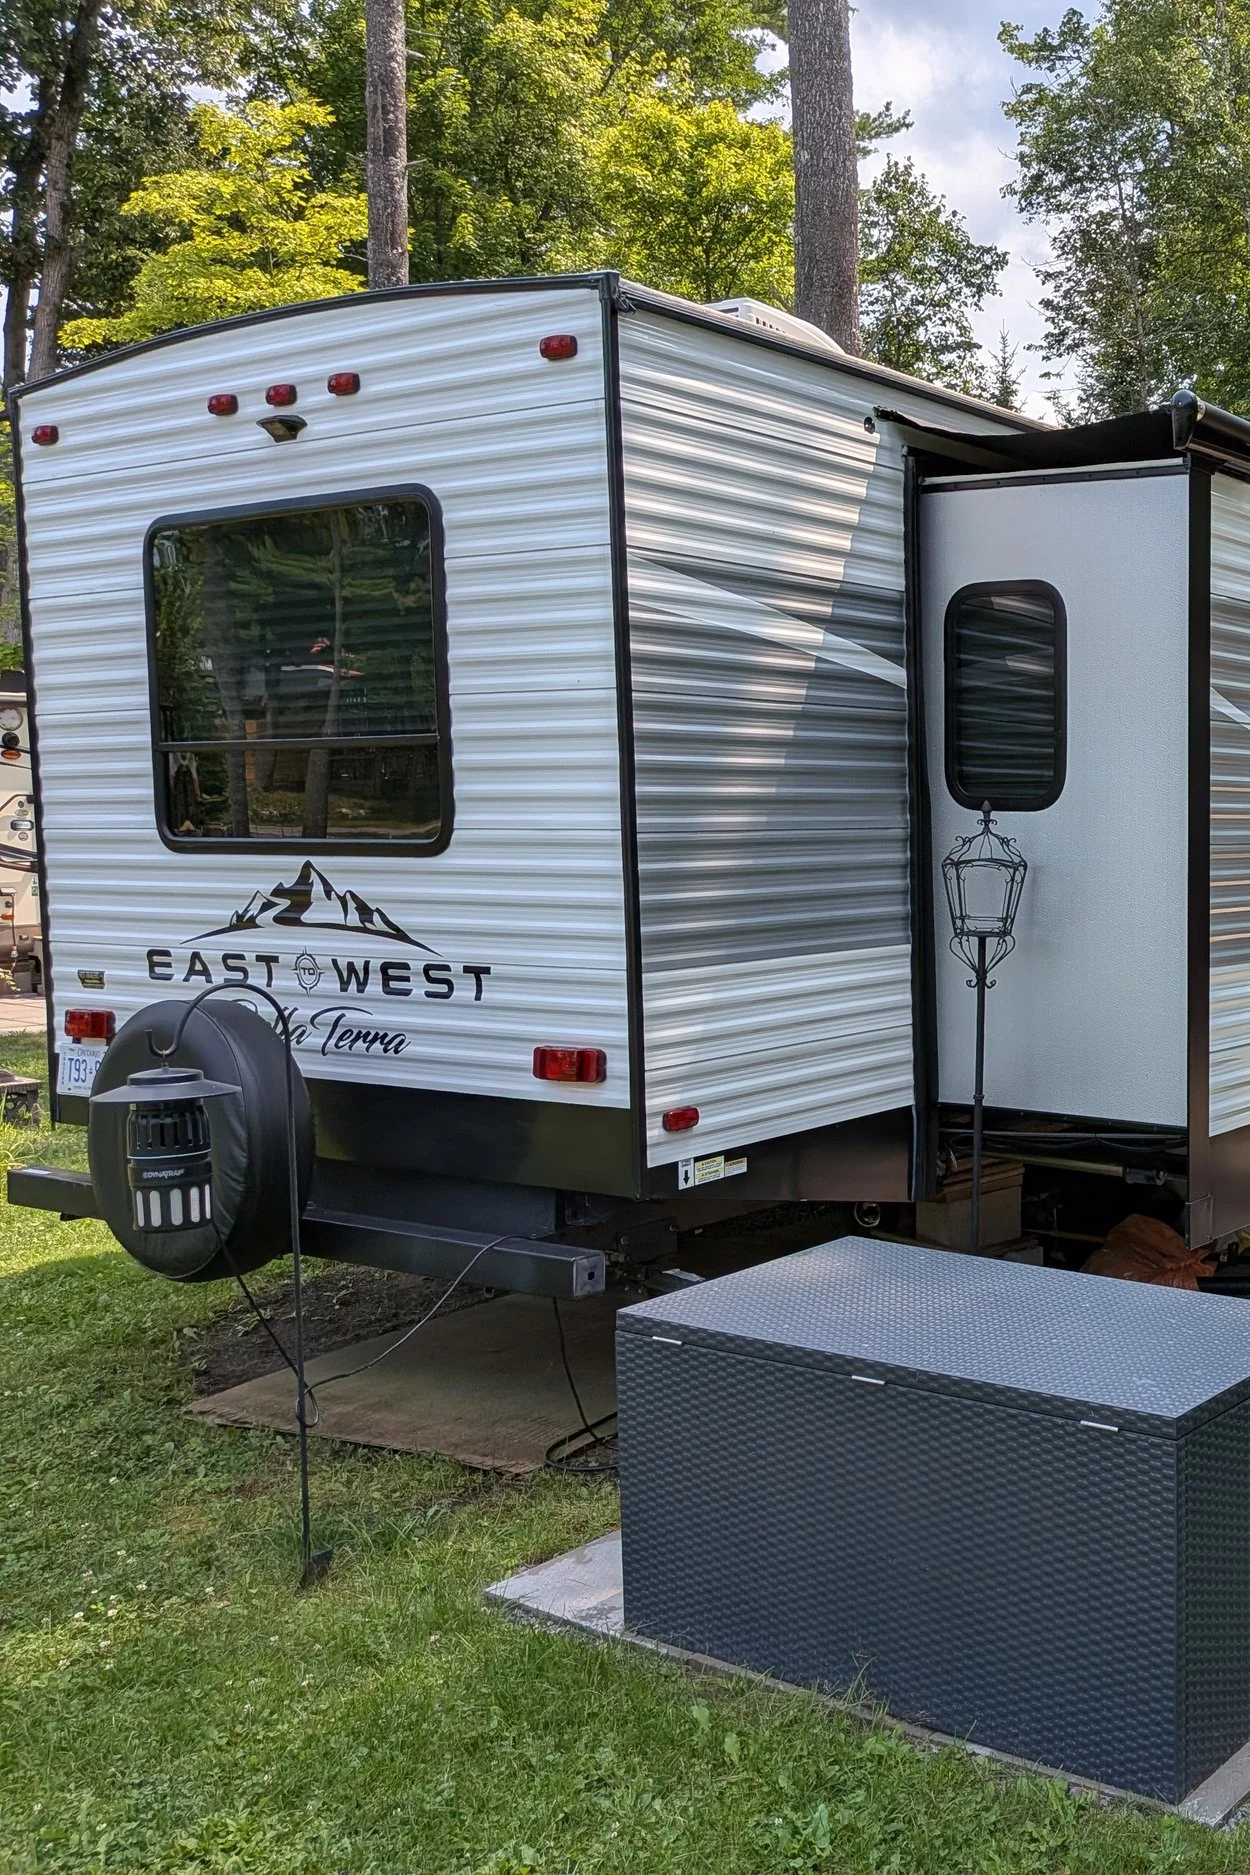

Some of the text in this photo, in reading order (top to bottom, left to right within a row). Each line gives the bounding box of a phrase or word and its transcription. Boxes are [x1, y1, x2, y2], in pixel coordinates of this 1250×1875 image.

[146, 948, 280, 988] EAST
[300, 966, 316, 976] TO
[331, 957, 492, 1002] WEST
[310, 1005, 412, 1057] Terra
